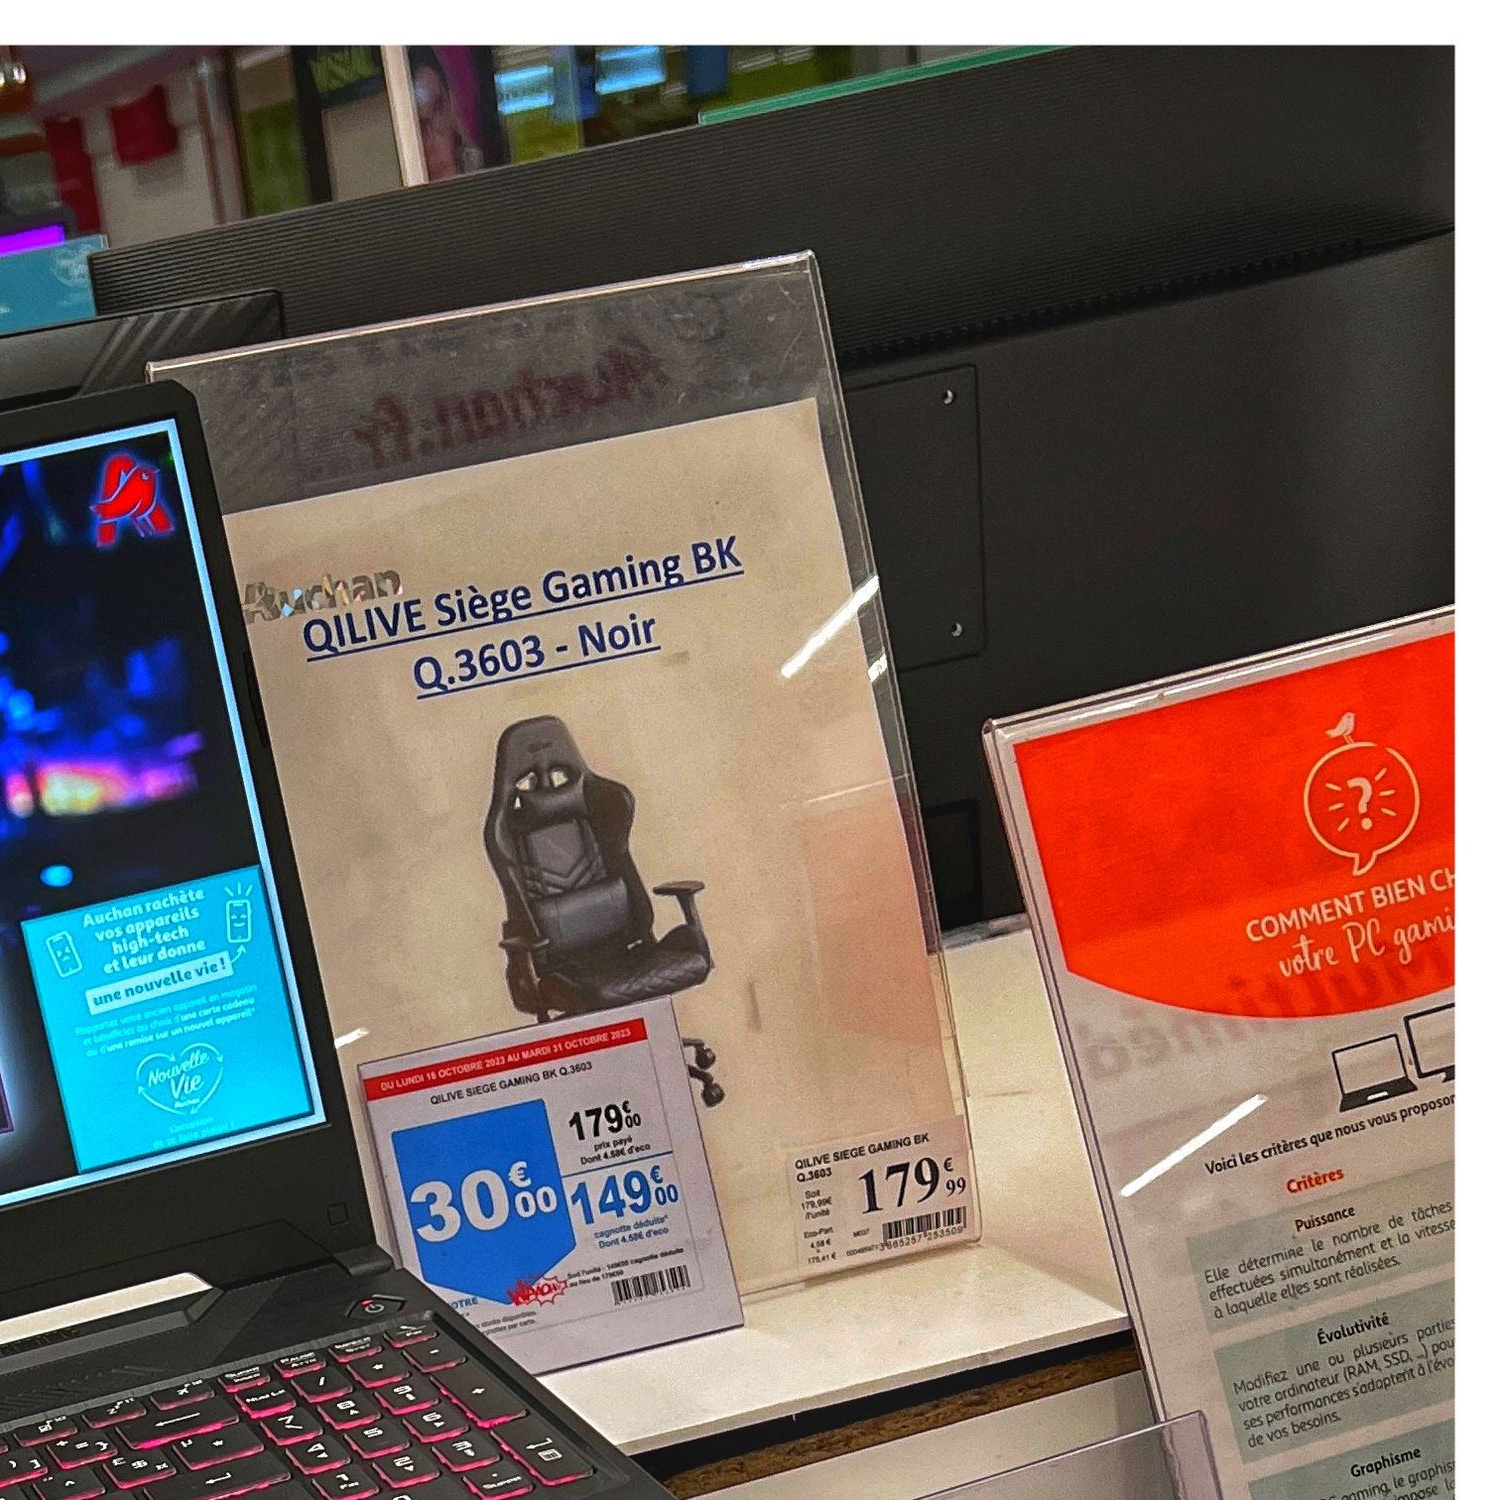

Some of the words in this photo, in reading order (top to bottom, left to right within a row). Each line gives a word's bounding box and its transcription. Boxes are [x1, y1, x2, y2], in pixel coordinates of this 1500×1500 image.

[302, 600, 427, 655] QILIVE
[435, 590, 532, 628] Siège
[540, 552, 682, 604] Gaming
[691, 535, 744, 578] BK
[413, 634, 546, 693] Q.3603
[577, 612, 657, 656] Noir
[83, 902, 143, 928] Auchan
[145, 889, 205, 912] rachète
[94, 923, 123, 942] vos
[126, 907, 200, 935] appareils
[1245, 891, 1366, 943] COMMENT
[1371, 876, 1426, 909] BIEN
[112, 926, 189, 955] high-tech
[122, 952, 155, 970] leur
[157, 939, 206, 962] donne
[1279, 934, 1340, 978] votre
[1343, 920, 1381, 965] PC
[93, 991, 122, 1006] une
[124, 970, 193, 999] nouvelle
[195, 961, 217, 977] vie
[395, 1073, 425, 1089] LUNDI
[438, 1061, 483, 1079] OCTOBRE
[430, 1088, 465, 1105] QILIVE
[466, 1082, 497, 1098] SIEGE
[498, 1072, 540, 1090] GAMING
[542, 1067, 558, 1080] BK
[558, 1061, 593, 1077] Q.3603
[795, 1154, 831, 1170] QILIVE
[833, 1147, 865, 1162] SIEGE
[868, 1137, 911, 1155] GAMING
[914, 1133, 929, 1144] BK
[1205, 1158, 1238, 1175] Voici
[1240, 1151, 1259, 1166] les
[1261, 1139, 1308, 1159] critères
[1310, 1133, 1332, 1148] que
[1334, 1119, 1366, 1140] nous
[1367, 1111, 1398, 1134] vous
[1286, 1168, 1344, 1194] Critères
[1295, 1207, 1355, 1232] Puissance
[1317, 1313, 1389, 1344] Évolutivité
[1351, 1447, 1421, 1477] Graphisme
